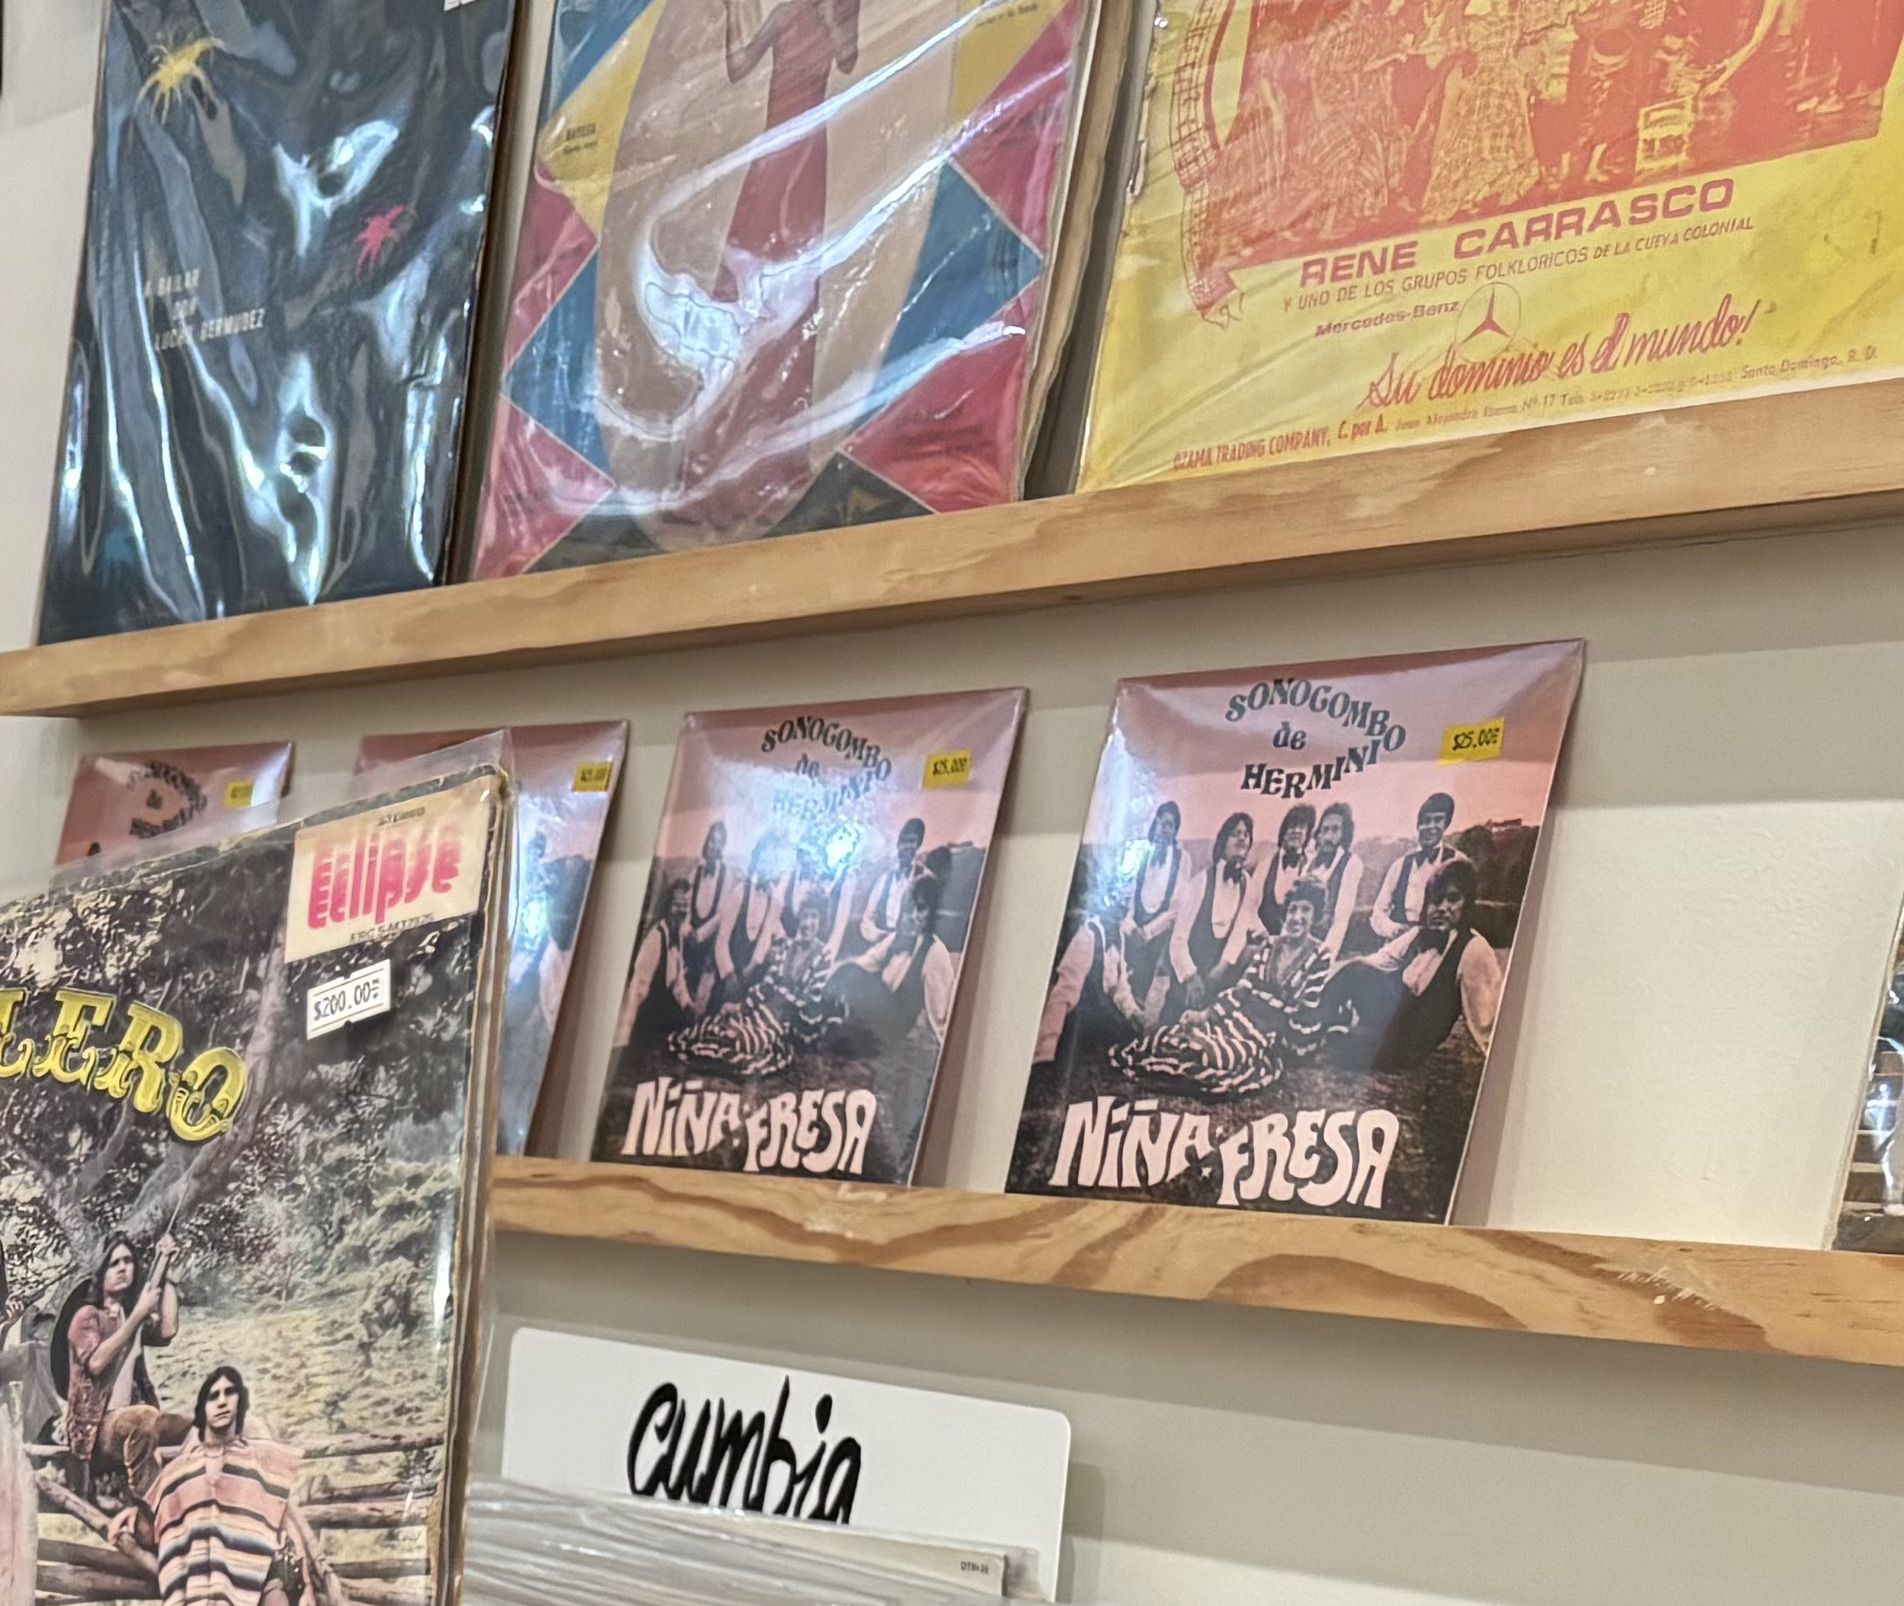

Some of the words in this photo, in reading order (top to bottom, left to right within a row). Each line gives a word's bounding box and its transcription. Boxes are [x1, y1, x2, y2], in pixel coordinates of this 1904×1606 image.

[1299, 241, 1418, 288] RENE
[1454, 178, 1734, 260] CARRASCO
[1337, 286, 1358, 303] DE
[1364, 279, 1395, 298] LOS
[1402, 268, 1467, 292] GRUPOS
[1476, 246, 1589, 282] FOLKLORICOS
[1593, 243, 1610, 259] DE
[1614, 243, 1631, 256] LA
[1683, 217, 1755, 242] COLONIAL
[1315, 301, 1460, 337] Mercedes-Benz
[1273, 721, 1307, 750] de
[306, 822, 464, 930] Eclipse
[313, 975, 371, 1021] $200.00
[743, 1088, 879, 1175] FRESA
[1215, 1108, 1400, 1208] FRESA
[628, 1375, 862, 1525] Cumbia
